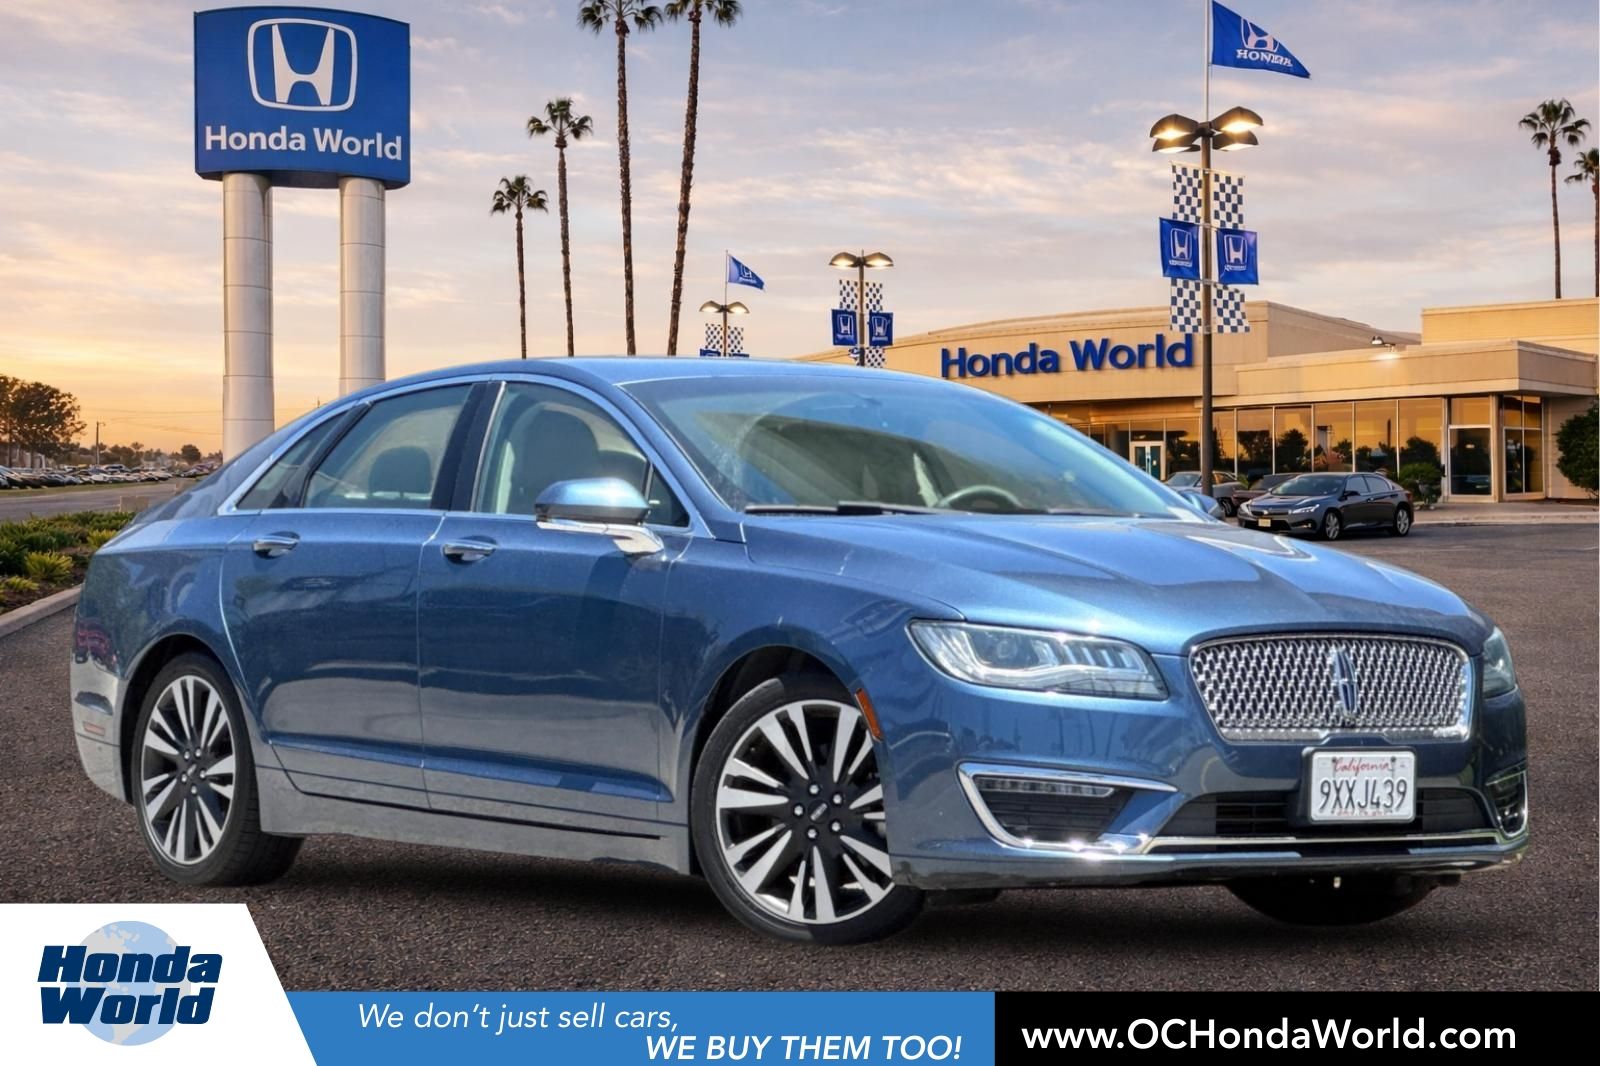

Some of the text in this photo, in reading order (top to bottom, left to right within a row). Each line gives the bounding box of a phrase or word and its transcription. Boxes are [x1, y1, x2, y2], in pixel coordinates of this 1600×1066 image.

[205, 125, 402, 161] Honda World
[941, 333, 1195, 378] Honda World
[1334, 757, 1394, 776] California
[1319, 778, 1408, 811] 9XXJ439
